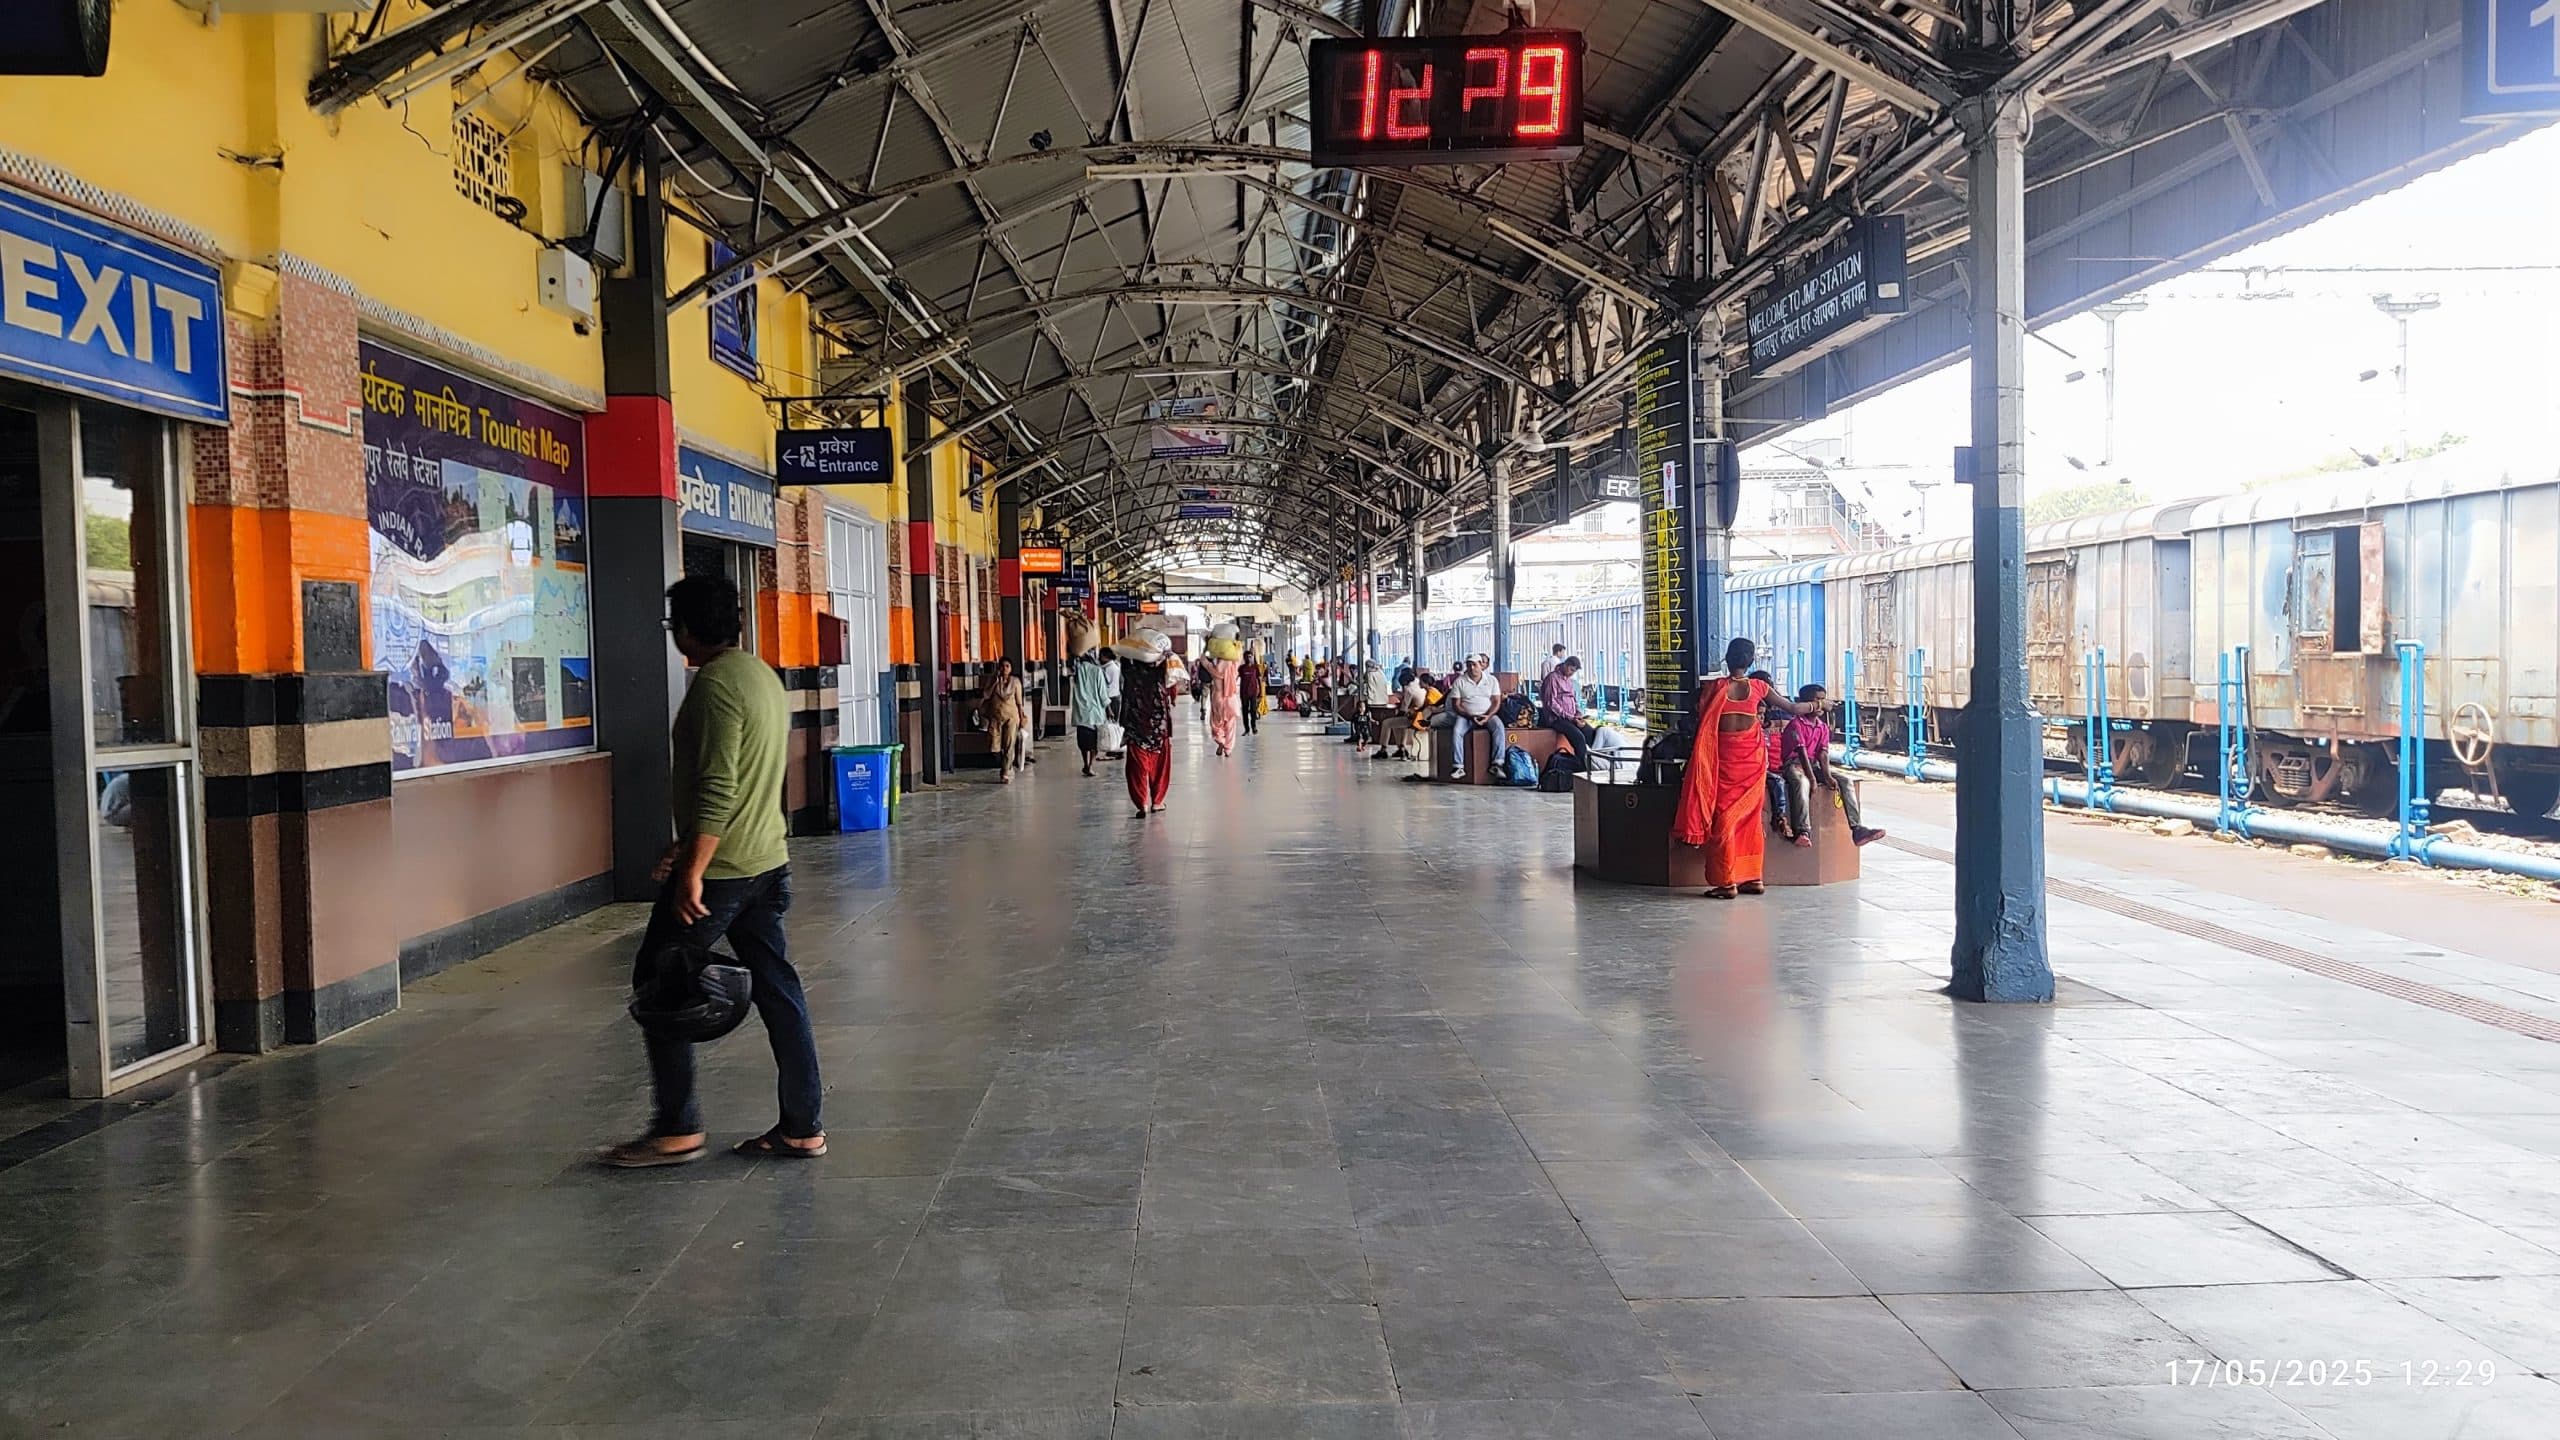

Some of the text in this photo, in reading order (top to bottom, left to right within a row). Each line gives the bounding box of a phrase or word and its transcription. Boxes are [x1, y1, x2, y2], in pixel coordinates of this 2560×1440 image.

[0, 230, 204, 374] EXIT
[1749, 251, 1862, 336] WELCOME TO JMP STATION
[1800, 312, 1811, 334] पर
[1812, 296, 1839, 327] आपका
[413, 386, 471, 439] मानचित्र
[479, 407, 536, 458] Tourist
[540, 428, 570, 474] Map
[819, 435, 856, 455] प्रवेश
[387, 438, 409, 481] रेलवे
[412, 447, 442, 488] स्टेशन
[819, 459, 879, 473] Entrance
[378, 510, 415, 543] INDIAN
[728, 481, 774, 530] ENTRANCE
[423, 717, 452, 741] Station
